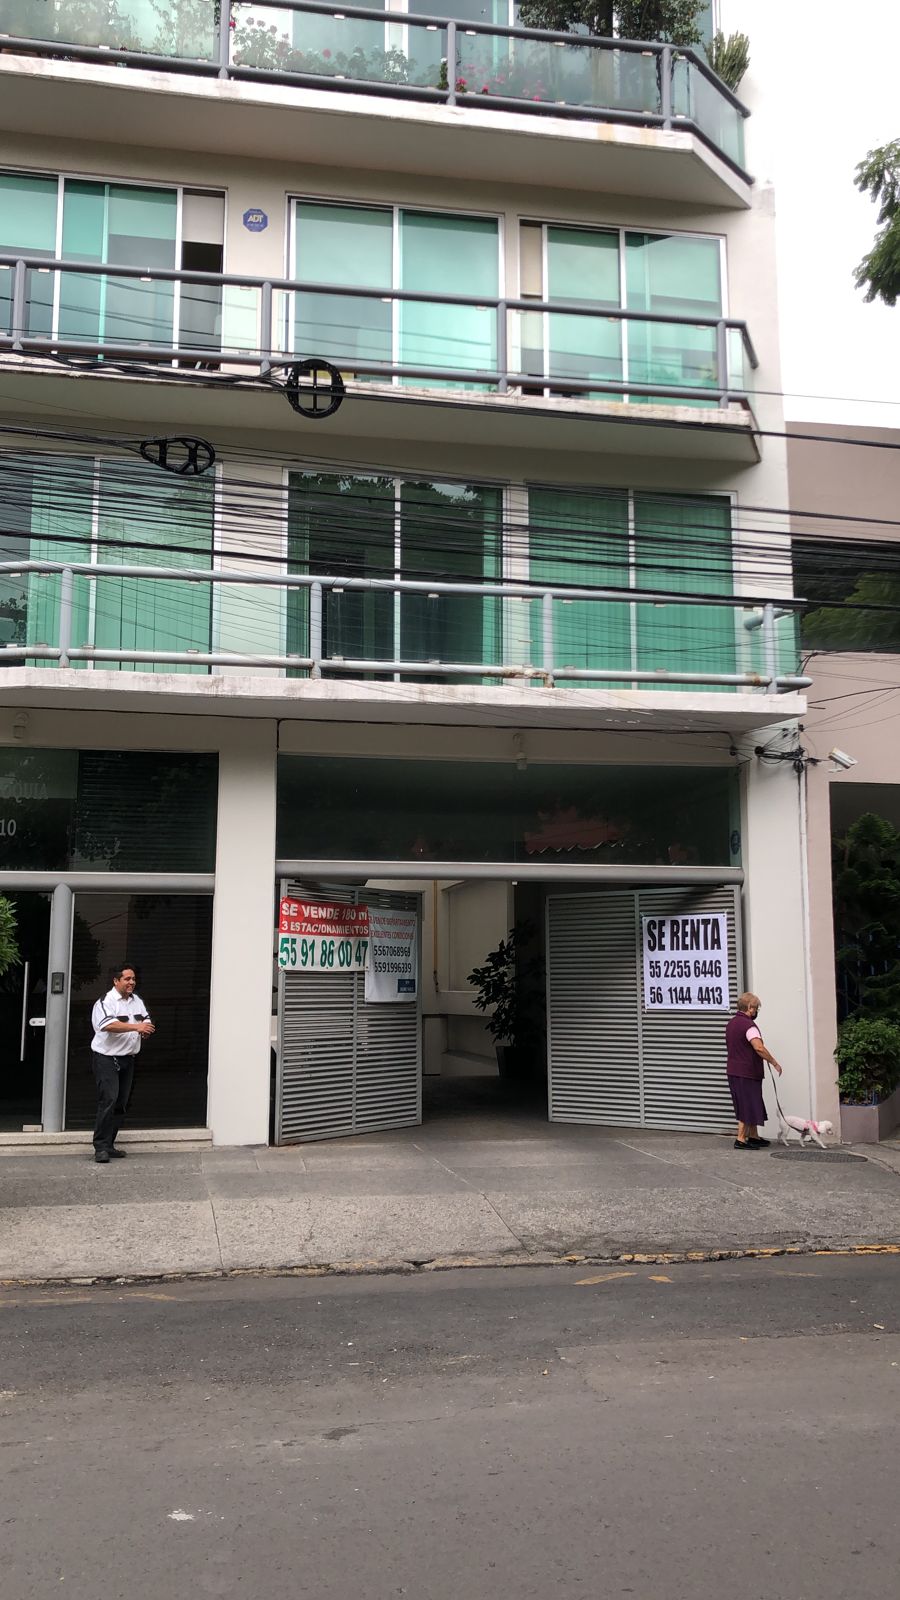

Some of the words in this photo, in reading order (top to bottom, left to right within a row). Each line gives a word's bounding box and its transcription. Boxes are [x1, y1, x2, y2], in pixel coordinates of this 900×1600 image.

[248, 214, 264, 223] ADT
[281, 903, 298, 917] SE
[301, 905, 339, 920] VENDE
[341, 909, 356, 921] 180
[281, 920, 289, 931] 3
[290, 921, 369, 935] ESTACIONAMIENTOS
[647, 919, 666, 952] SE
[670, 918, 721, 951] RENTA
[279, 937, 297, 966] 55
[301, 938, 315, 967] 91
[320, 940, 335, 968] 86
[338, 941, 352, 968] 00
[355, 940, 368, 967] 47
[649, 960, 662, 978] 55
[663, 960, 691, 978] 2255
[693, 960, 722, 978] 6446
[649, 986, 664, 1004] 56
[668, 986, 692, 1004] 1144
[697, 986, 723, 1005] 4413
